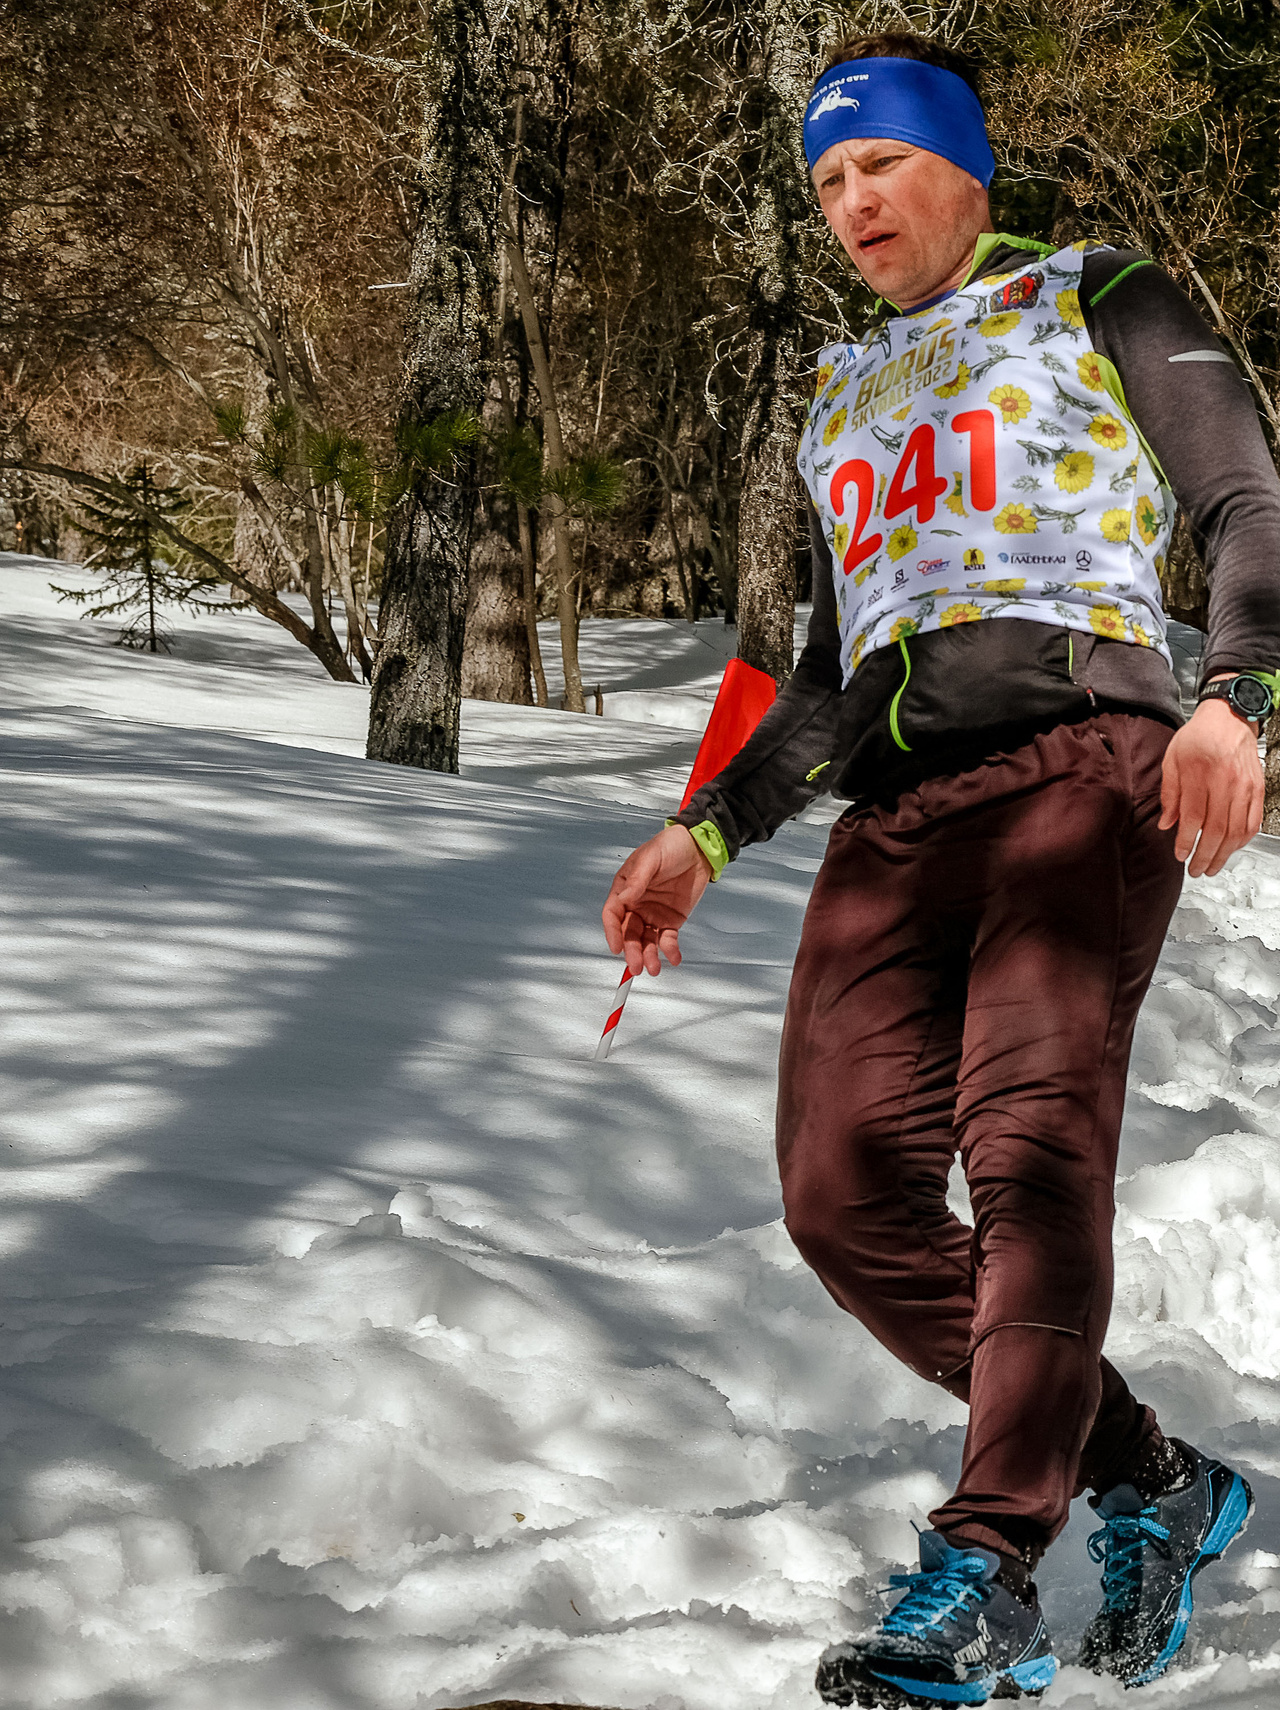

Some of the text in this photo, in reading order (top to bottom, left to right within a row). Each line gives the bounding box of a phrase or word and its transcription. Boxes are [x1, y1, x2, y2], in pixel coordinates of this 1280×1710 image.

[846, 74, 869, 82] MAD
[851, 360, 952, 433] SKYRACE 2022
[853, 327, 957, 413] BORUS
[829, 409, 996, 576] 241
